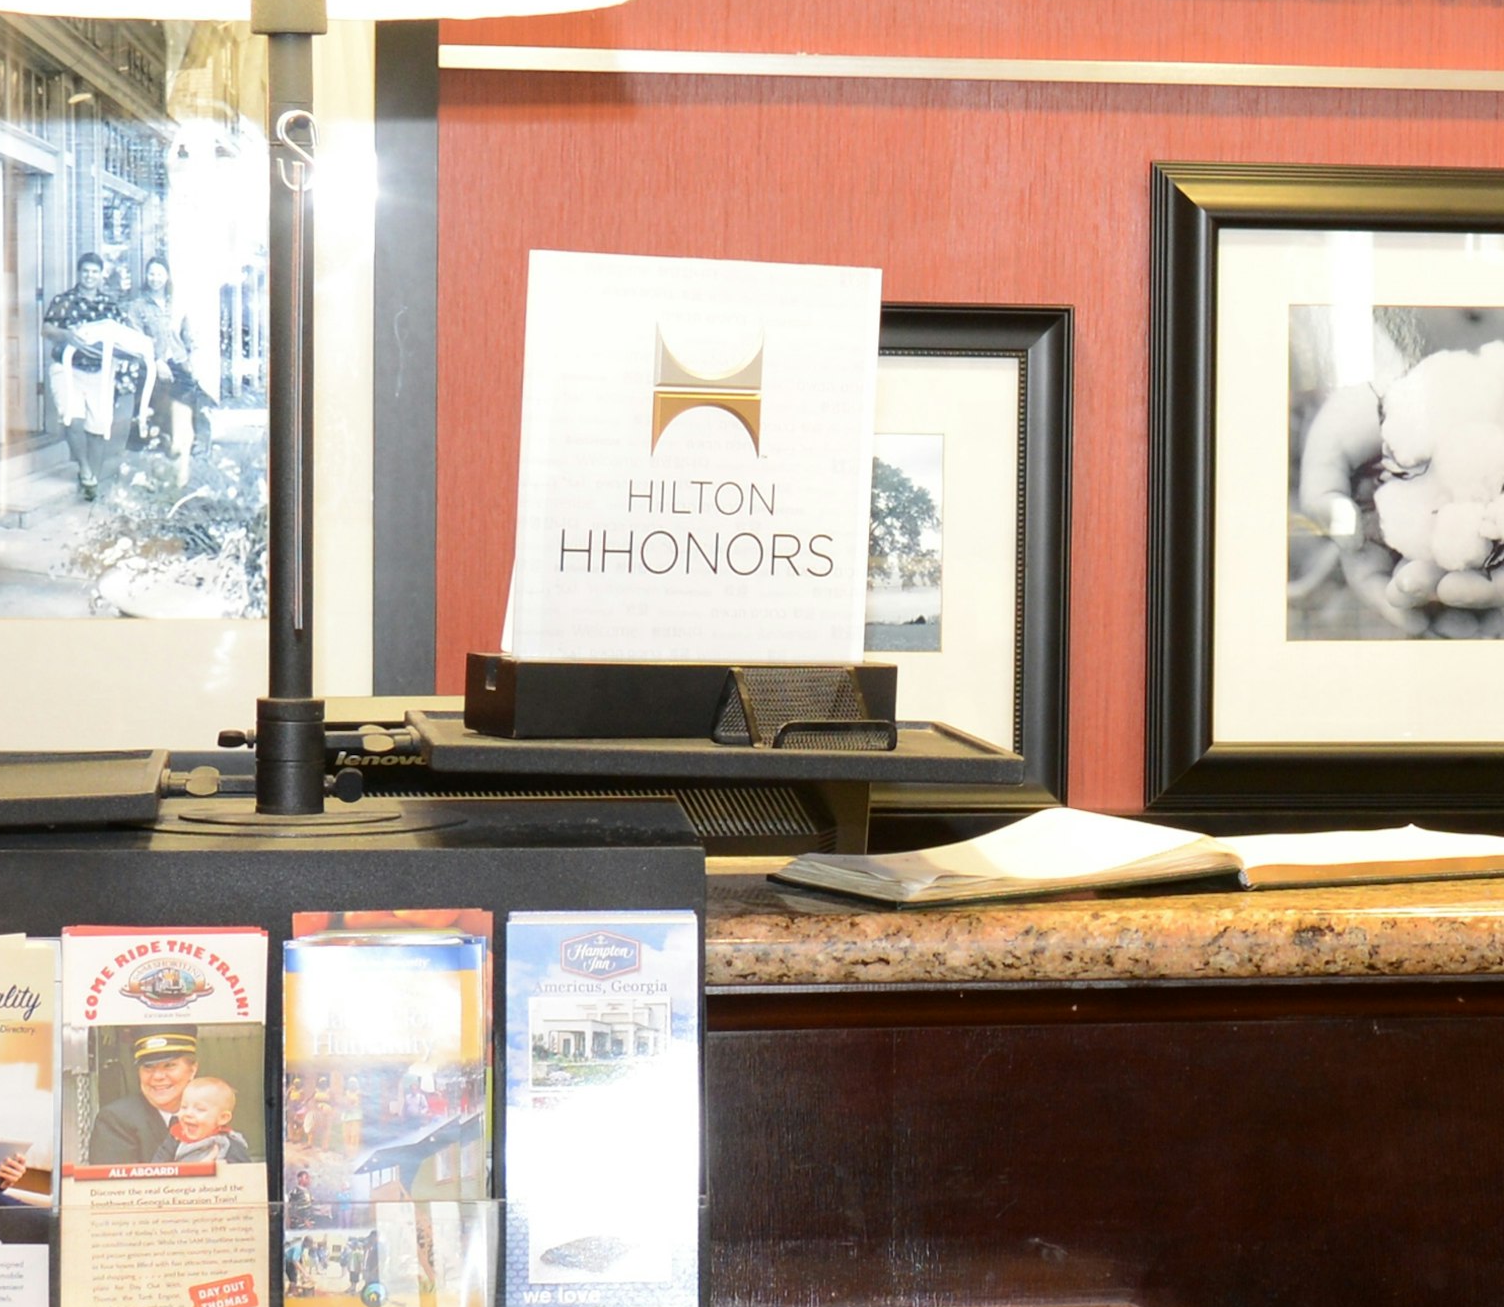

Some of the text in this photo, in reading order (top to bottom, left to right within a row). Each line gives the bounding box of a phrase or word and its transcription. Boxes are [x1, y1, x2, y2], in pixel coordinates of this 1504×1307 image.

[629, 479, 775, 516] HILTON
[560, 528, 834, 578] HHONORS
[567, 943, 634, 962] Hampton
[583, 957, 616, 973] Inn
[84, 939, 249, 1021] COME RIDE THE TRAIN!
[533, 979, 669, 995] Americus, Georgia
[312, 1032, 432, 1063] Humity
[108, 1166, 179, 1178] ALL ABOARD!
[90, 1184, 244, 1197] Discover the real Georgia aboard the
[171, 1196, 212, 1206] Excursion
[198, 1280, 246, 1300] DAY OUT
[522, 1286, 601, 1305] we love
